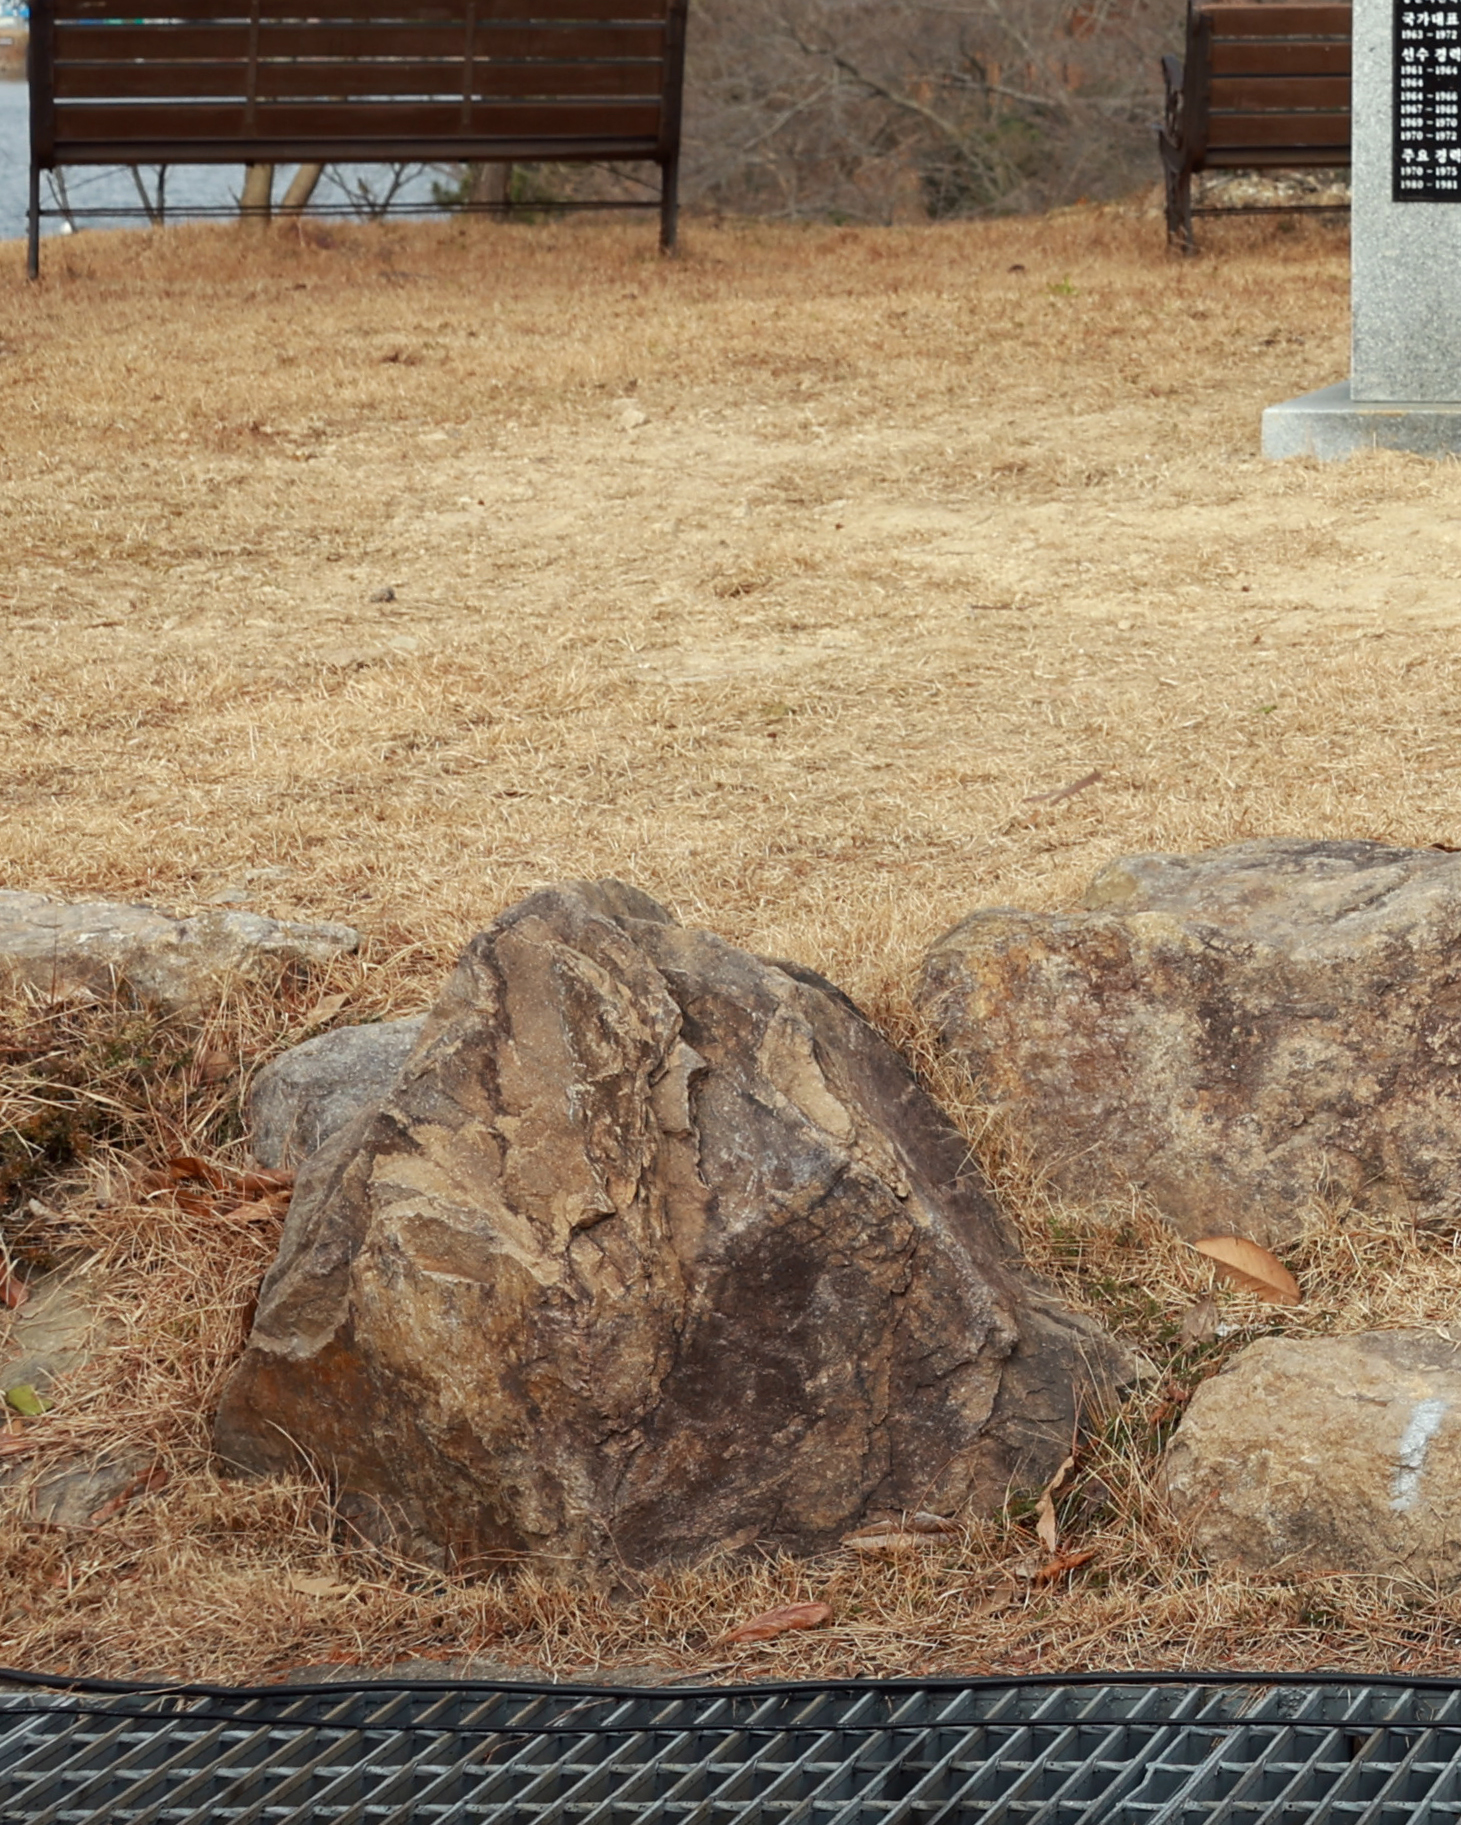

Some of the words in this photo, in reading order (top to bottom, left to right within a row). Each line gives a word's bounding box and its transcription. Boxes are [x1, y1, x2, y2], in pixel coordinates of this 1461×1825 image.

[1402, 11, 1460, 26] 국가대표
[1401, 46, 1430, 62] 선수
[1434, 46, 1461, 62] 경력
[1401, 148, 1430, 163] 주요
[1434, 147, 1461, 163] 경력
